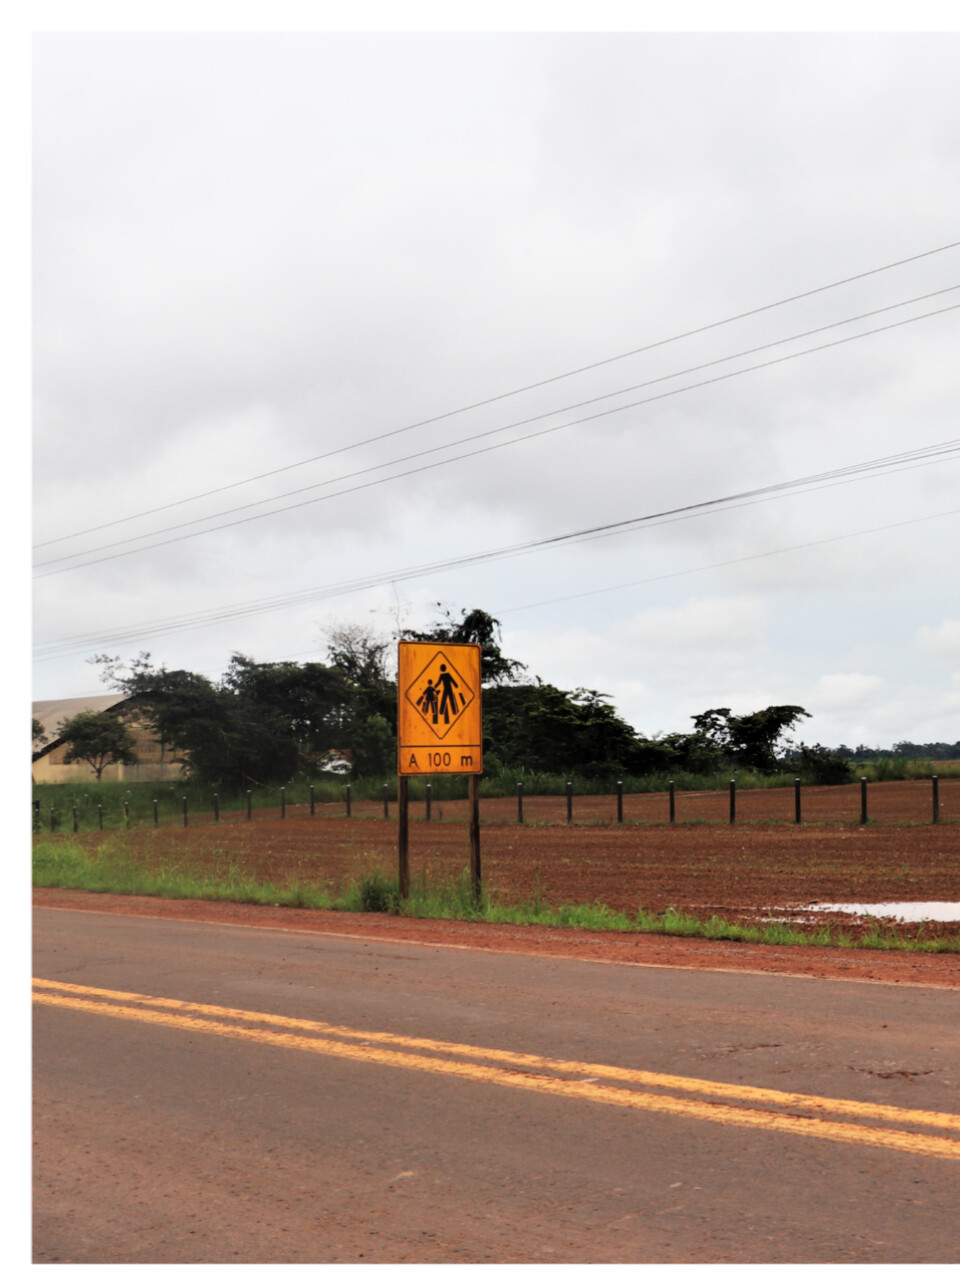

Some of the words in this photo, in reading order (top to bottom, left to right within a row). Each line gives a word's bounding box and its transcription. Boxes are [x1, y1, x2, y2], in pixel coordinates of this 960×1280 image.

[408, 753, 419, 769] A
[428, 752, 452, 767] 100
[461, 755, 473, 766] m
